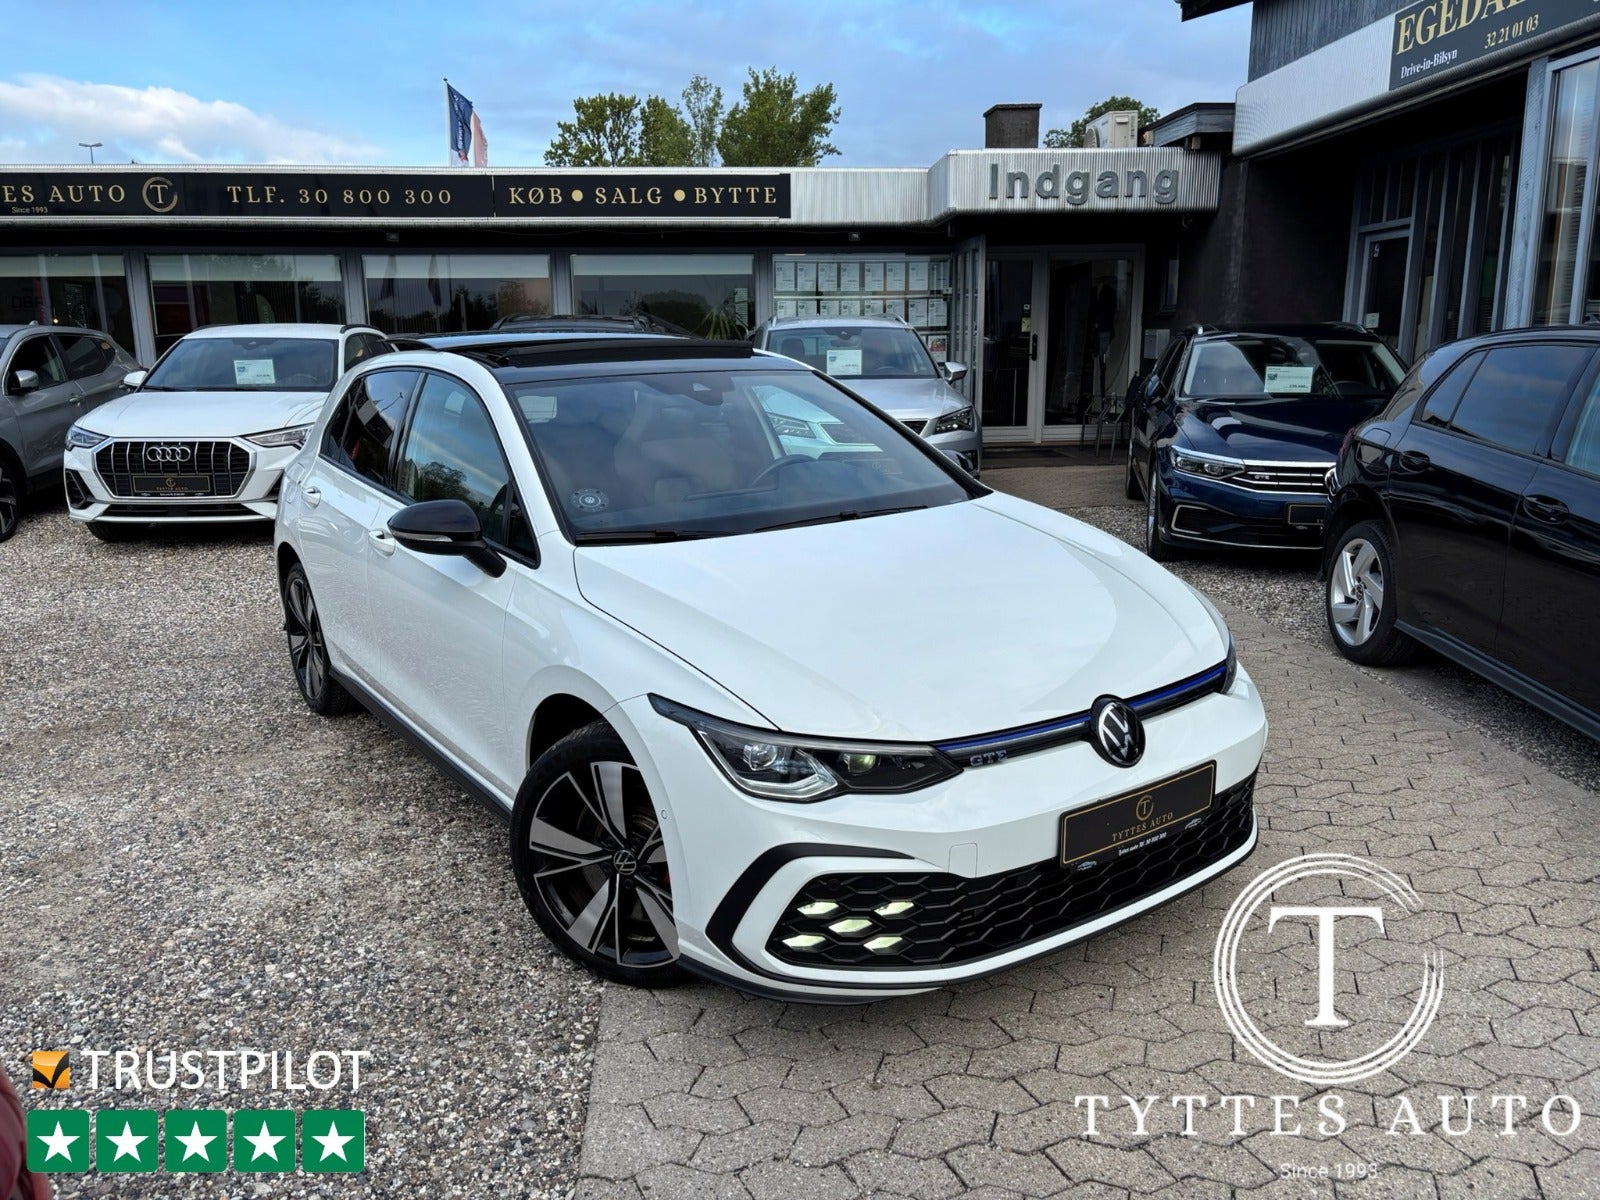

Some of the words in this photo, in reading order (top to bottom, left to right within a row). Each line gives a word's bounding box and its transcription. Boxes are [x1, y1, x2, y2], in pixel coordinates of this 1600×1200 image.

[1396, 0, 1527, 55] EGEDA
[1484, 31, 1497, 49] 32
[1498, 25, 1510, 44] 21
[1512, 20, 1524, 39] 01
[1526, 14, 1539, 33] 03
[1400, 49, 1458, 79] Drive-in-Bilsyn
[48, 184, 126, 203] AUTO
[226, 185, 286, 204] TLF.
[298, 188, 328, 204] 30
[343, 188, 391, 205] 800
[404, 188, 451, 205] 300
[508, 186, 563, 205] KØB
[595, 186, 663, 205] SALG
[694, 186, 777, 204] BYTTE
[989, 163, 1180, 205] Indgang
[11, 206, 30, 214] Since
[31, 206, 48, 214] 1993
[1111, 822, 1147, 842] TYTTES
[1150, 811, 1173, 828] AUTO
